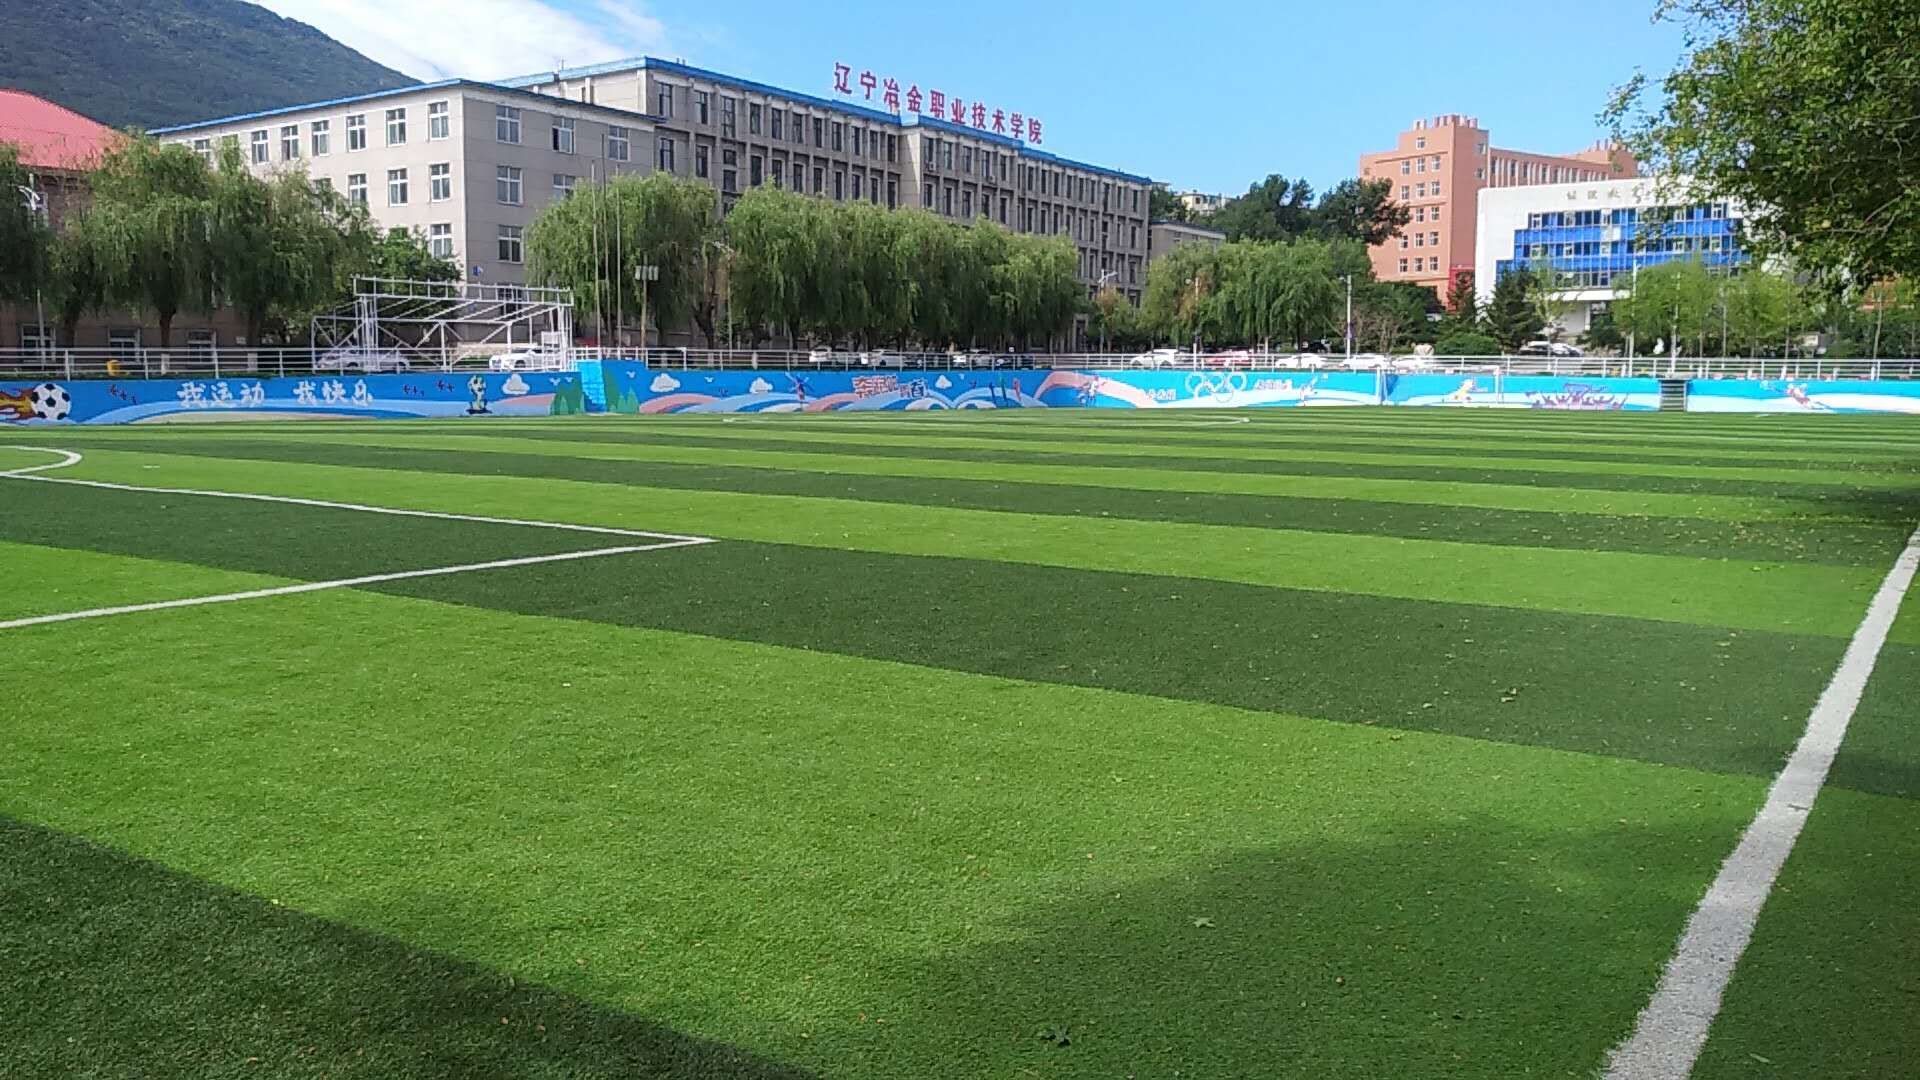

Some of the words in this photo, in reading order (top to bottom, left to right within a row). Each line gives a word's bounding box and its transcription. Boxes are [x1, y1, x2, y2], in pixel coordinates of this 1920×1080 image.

[834, 62, 1043, 144] 辽宁冶金职业技术学院
[177, 381, 265, 408] 我运动
[293, 378, 373, 406] 我快乐
